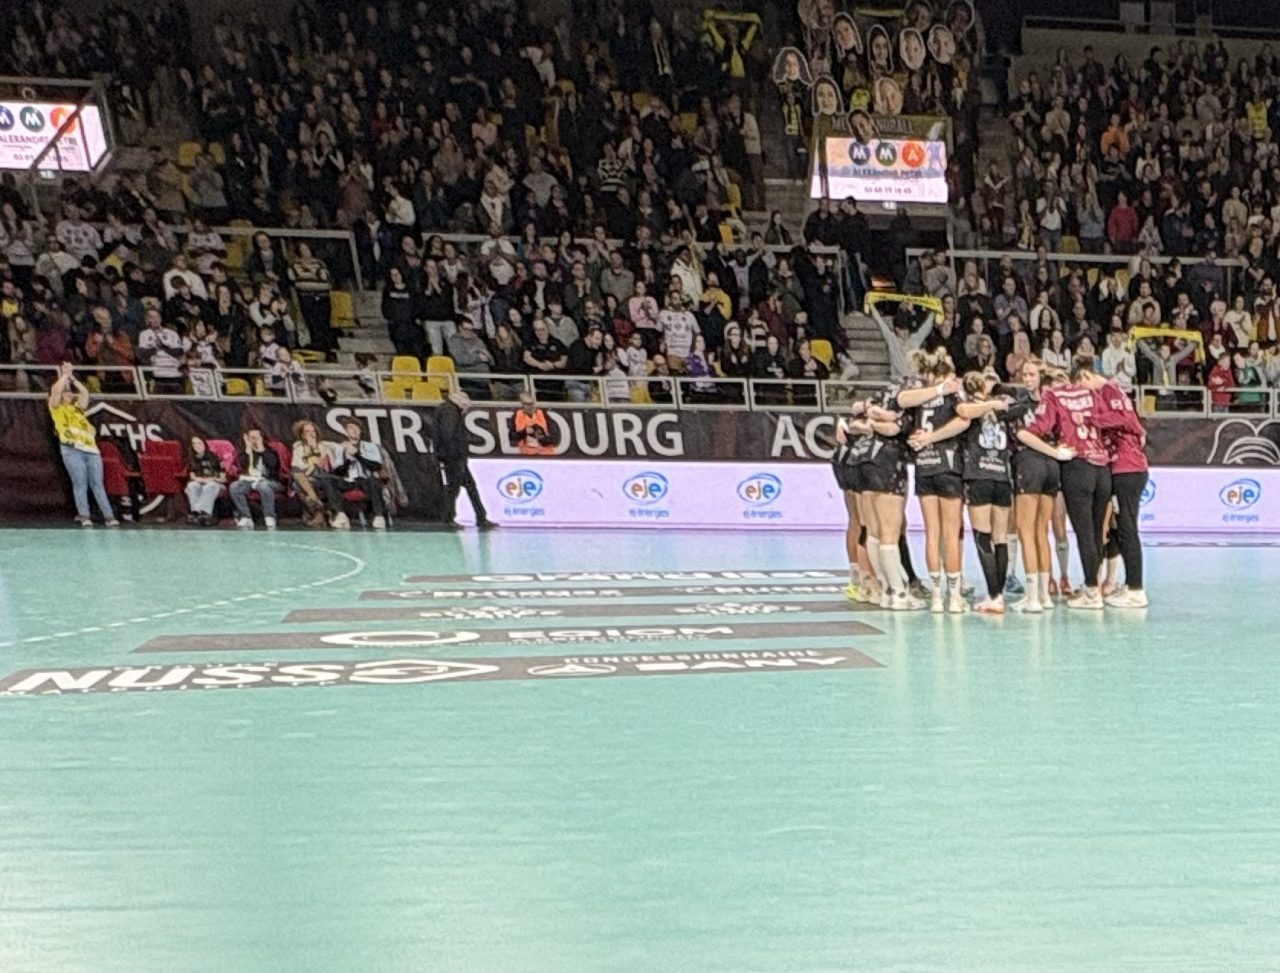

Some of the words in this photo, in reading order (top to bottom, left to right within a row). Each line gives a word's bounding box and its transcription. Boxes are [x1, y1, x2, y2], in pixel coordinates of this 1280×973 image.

[564, 650, 822, 663] CONCESSIONNAIRE
[636, 657, 848, 672] SANY
[8, 664, 345, 691] NUSS
